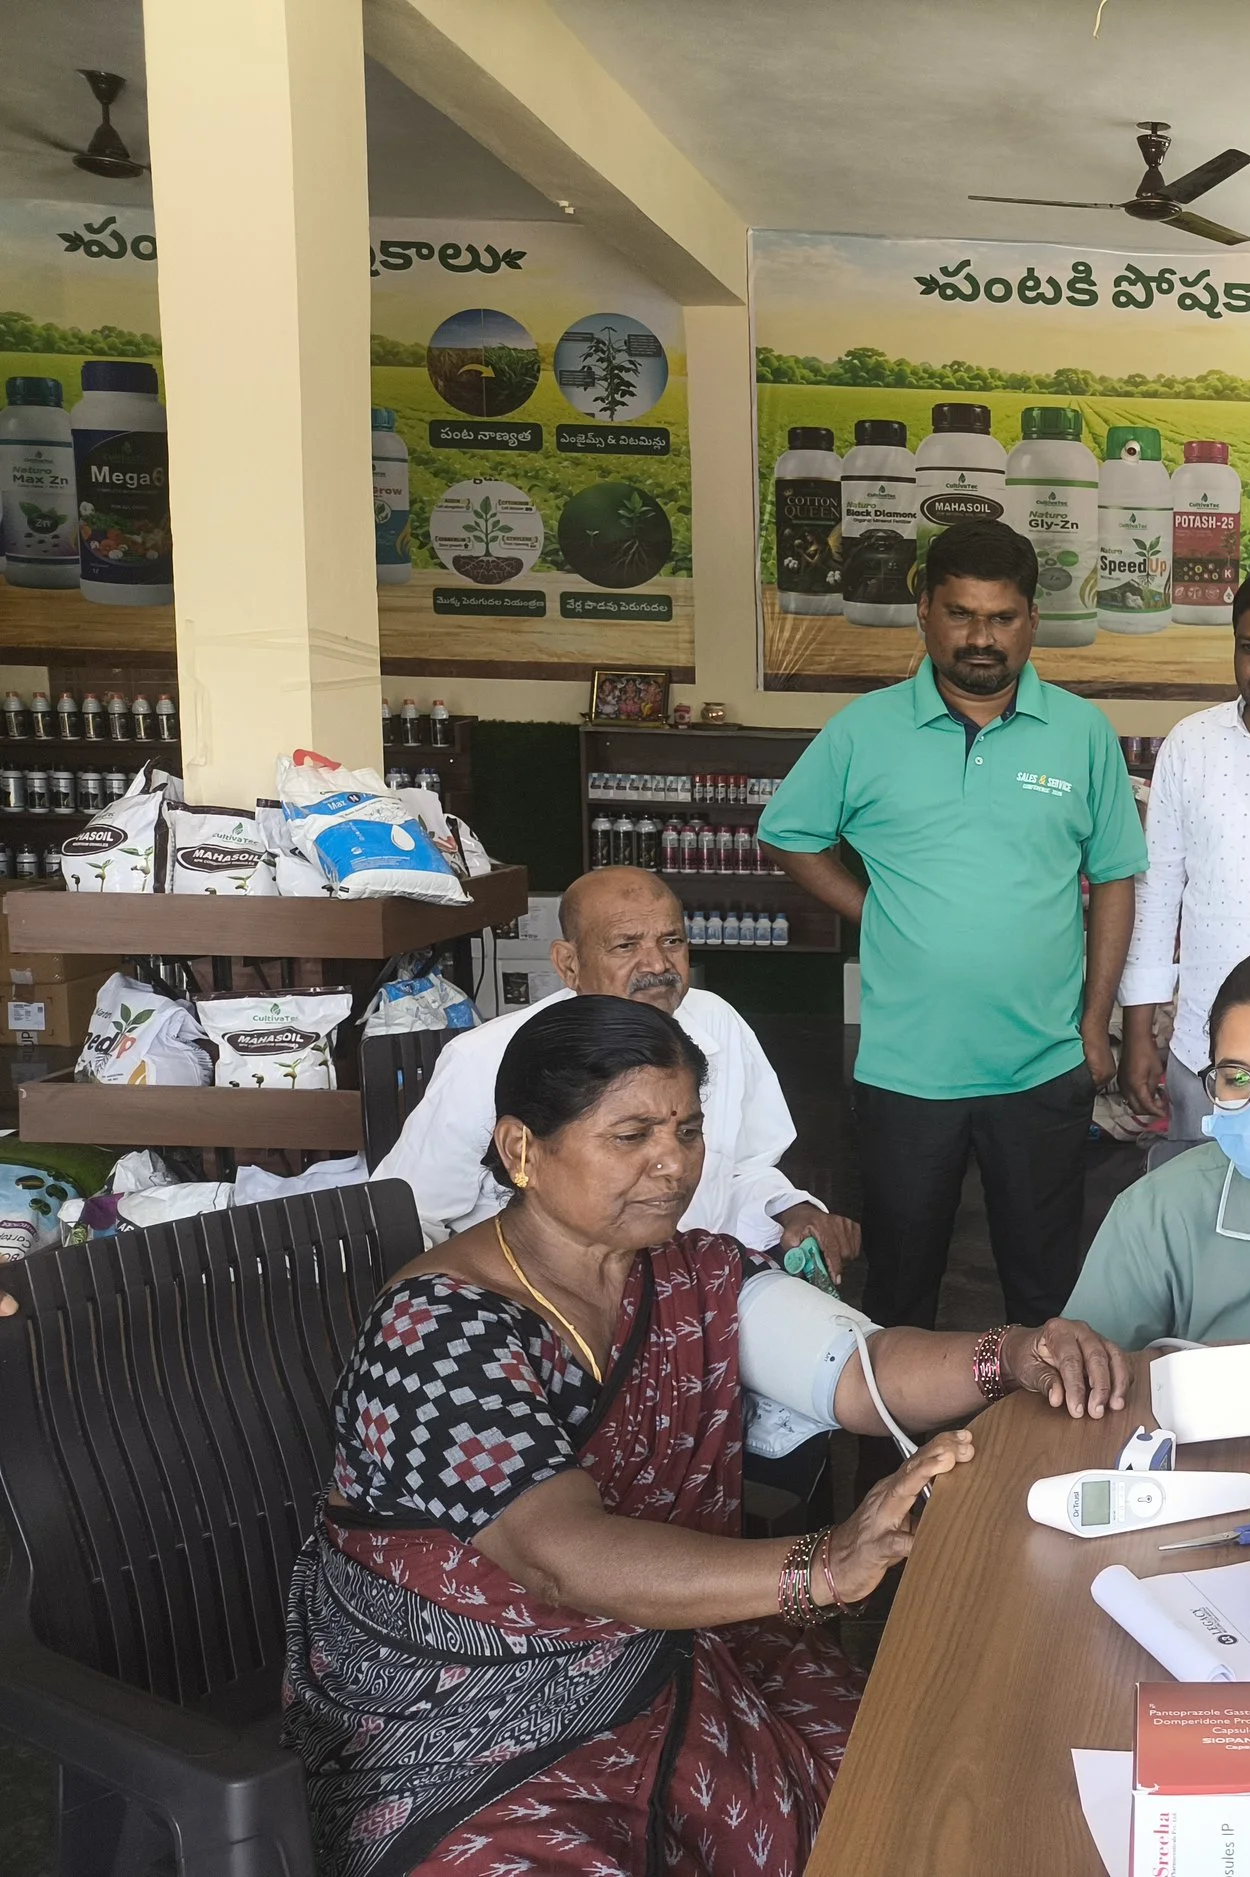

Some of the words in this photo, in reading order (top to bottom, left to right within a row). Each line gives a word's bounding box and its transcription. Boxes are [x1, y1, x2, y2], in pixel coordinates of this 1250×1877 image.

[938, 259, 1099, 307] పంటకి
[440, 428, 474, 438] పంట
[477, 430, 532, 447] నాణ్యత
[607, 435, 616, 445] &
[12, 474, 45, 484] Max
[50, 475, 69, 486] Zn
[787, 496, 838, 507] COTTON
[935, 501, 991, 513] MAHASOIL
[784, 505, 840, 519] QUEEN
[846, 509, 872, 517] Black
[1029, 510, 1068, 520] Naturo
[1028, 520, 1079, 530] Gly-Zn
[1175, 514, 1235, 529] POTASH-25
[1016, 772, 1038, 783] SALES
[1039, 774, 1046, 785] &
[1047, 777, 1073, 792] SERVICE
[192, 849, 261, 863] MAHASOIL
[237, 1032, 304, 1044] MAHASOIL
[1149, 1709, 1221, 1717] Pantoprazole
[1153, 1718, 1230, 1727] Domperidone
[1221, 1823, 1235, 1836] IP
